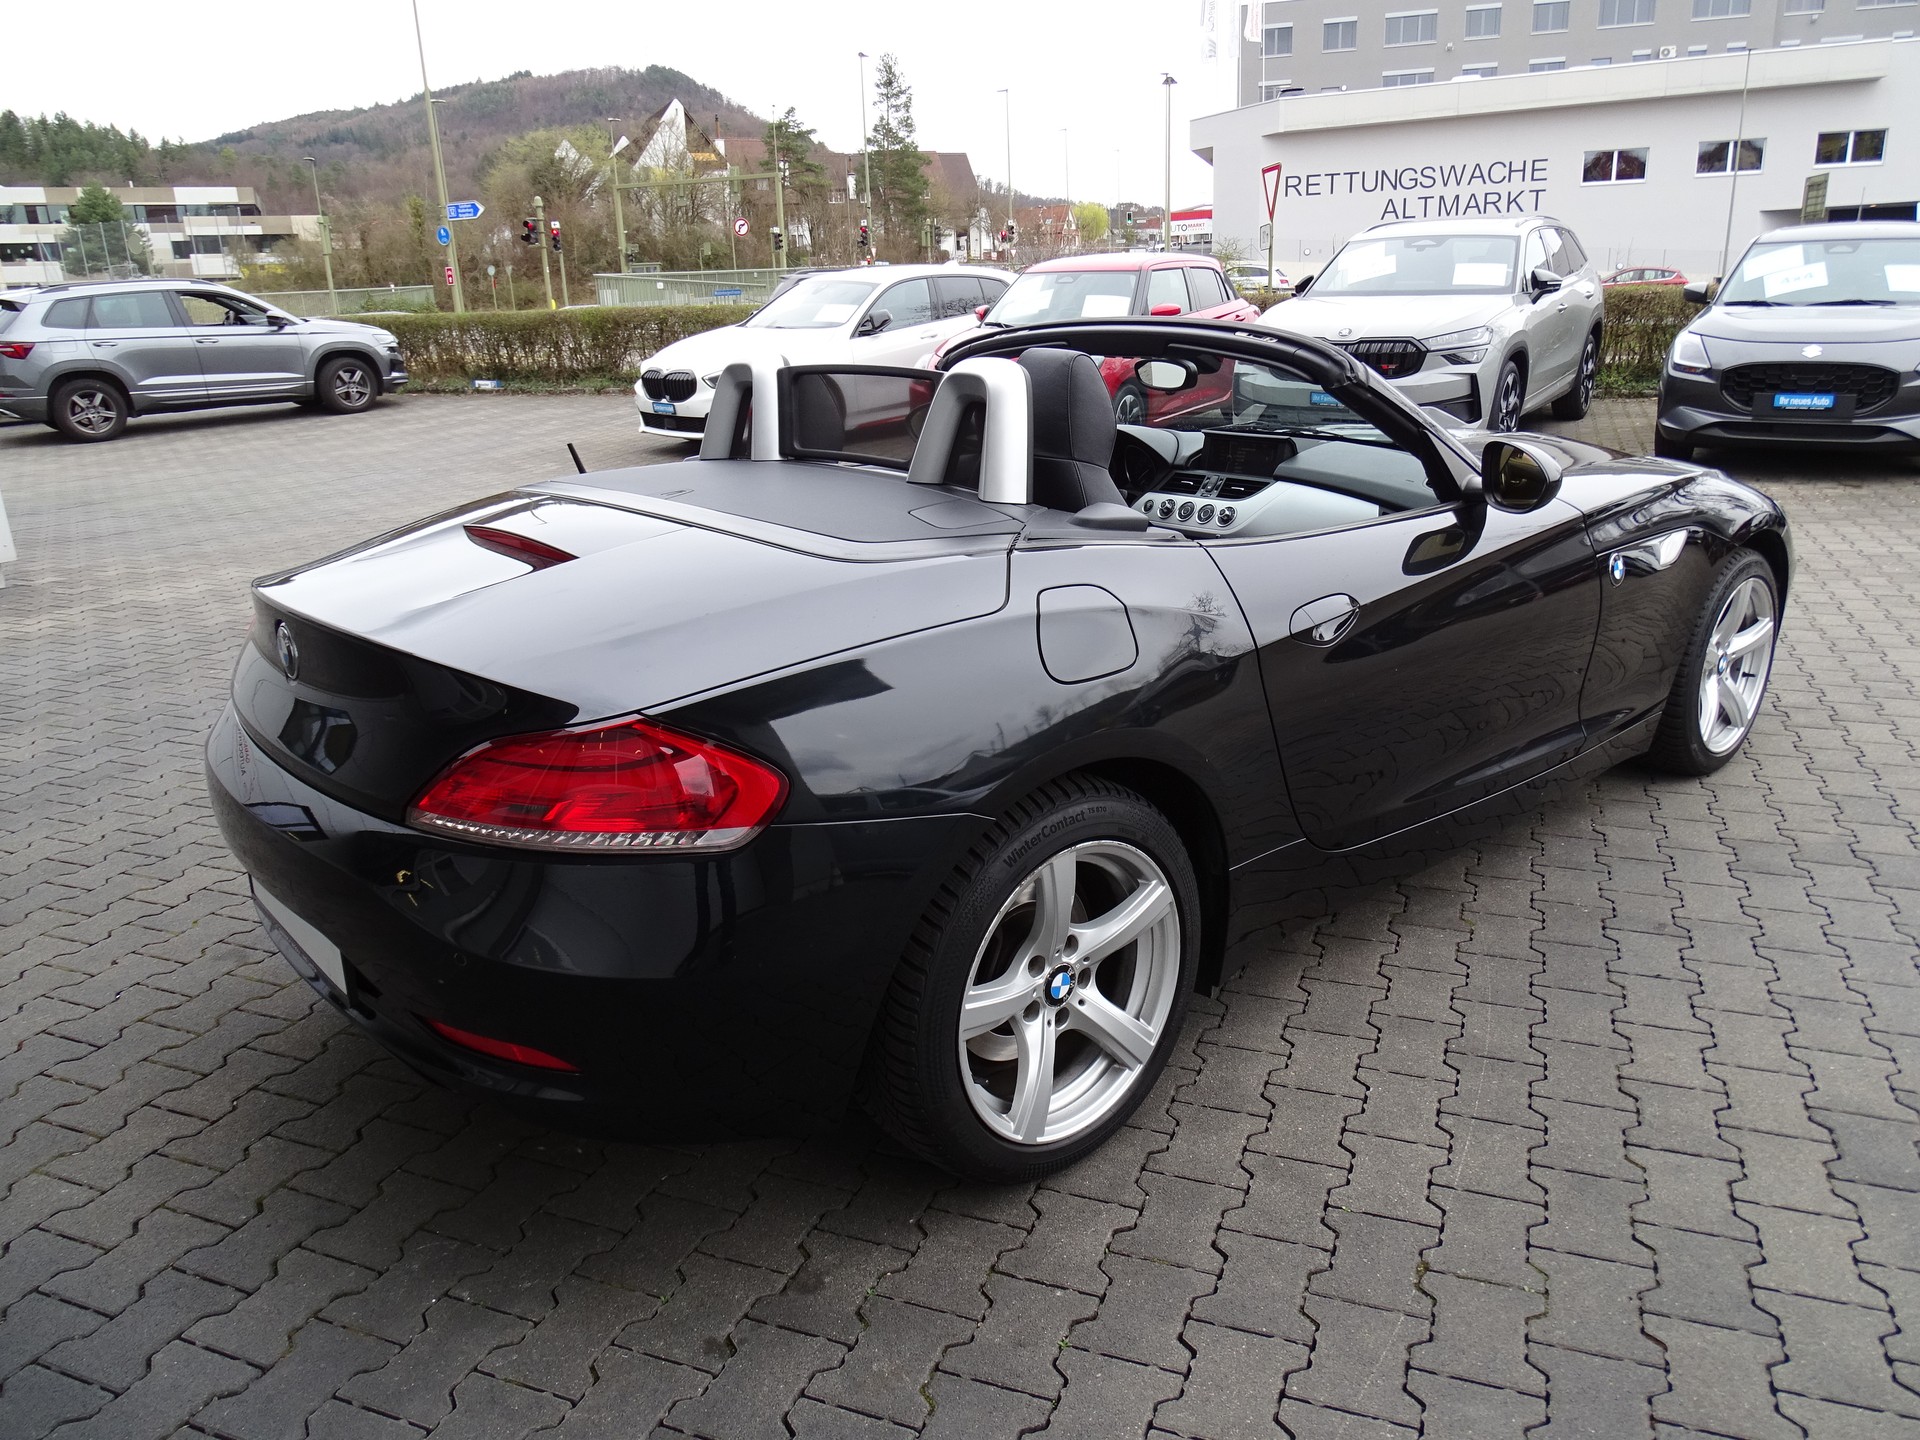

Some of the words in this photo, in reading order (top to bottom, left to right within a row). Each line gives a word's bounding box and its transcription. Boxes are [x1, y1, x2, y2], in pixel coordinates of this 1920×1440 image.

[1284, 158, 1549, 198] RETTUNGSWACHE
[1380, 189, 1547, 221] ALTMARKT
[1171, 223, 1188, 232] UTO
[1779, 397, 1789, 405] Ihr
[1812, 397, 1830, 406] Auto
[1003, 810, 1087, 868] WinterContact
